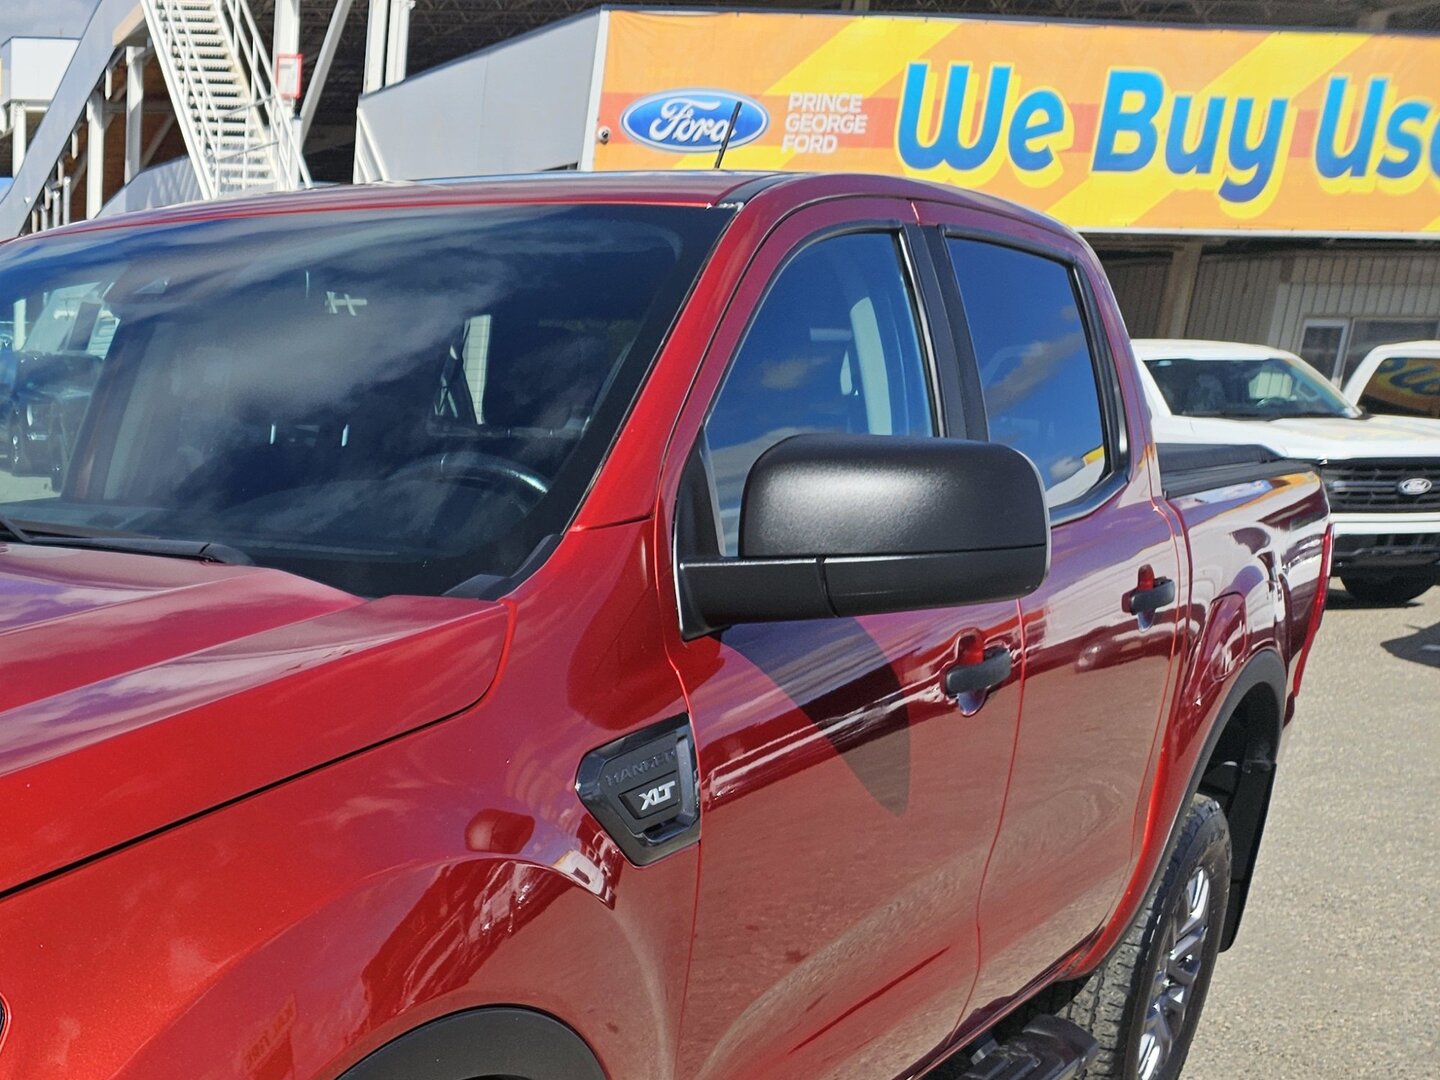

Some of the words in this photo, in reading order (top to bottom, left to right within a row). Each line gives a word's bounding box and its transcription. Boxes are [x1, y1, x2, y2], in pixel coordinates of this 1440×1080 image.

[787, 92, 864, 113] PRINCE
[784, 113, 869, 134] GEORGE
[897, 62, 1066, 172] We
[1092, 69, 1291, 203] Buy
[1314, 76, 1440, 180] Us
[781, 134, 839, 154] FORD
[639, 780, 676, 811] XLT
